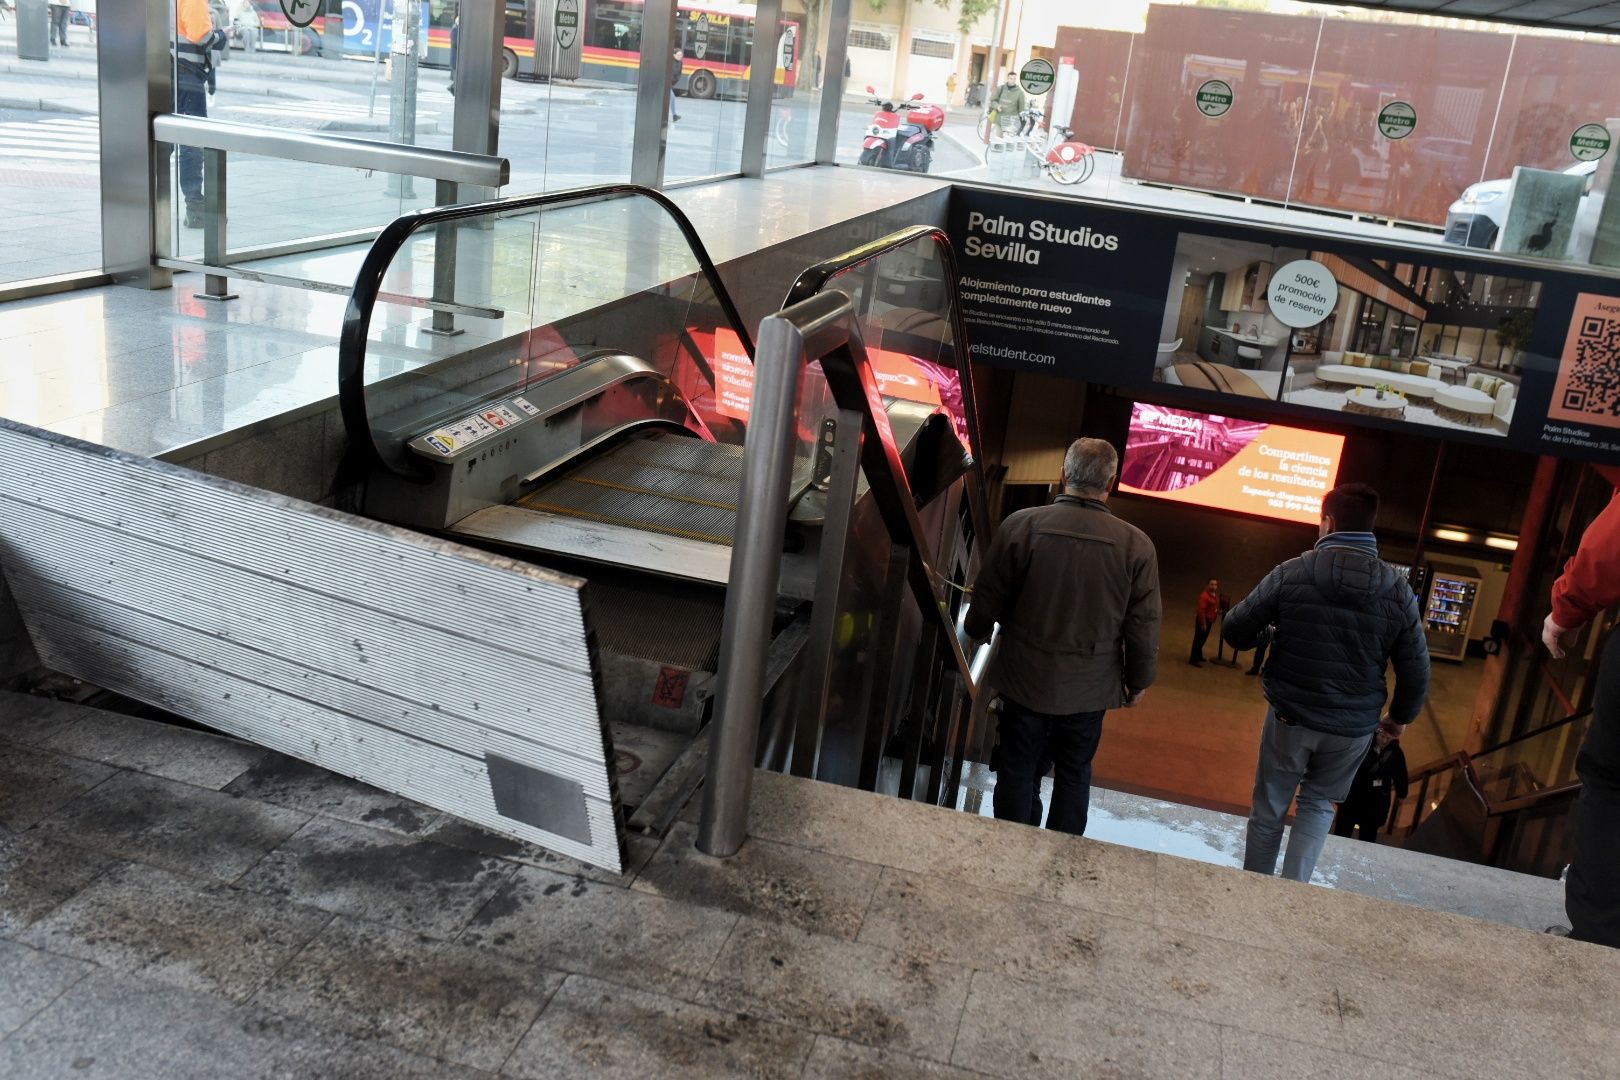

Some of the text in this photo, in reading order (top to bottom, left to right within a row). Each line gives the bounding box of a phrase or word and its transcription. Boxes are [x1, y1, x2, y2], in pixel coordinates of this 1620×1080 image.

[560, 13, 575, 24] Metro
[689, 11, 730, 25] SILLA
[1025, 72, 1050, 82] Metro
[1202, 93, 1227, 103] Metro
[1384, 115, 1410, 125] Metro
[1576, 138, 1604, 148] Metro
[968, 211, 1119, 251] Palm Studios
[965, 236, 1041, 265] Sevilla
[1295, 273, 1320, 288] 500€
[960, 276, 1111, 307] Alojamiento para estudiantes
[1277, 283, 1327, 304] promoción
[1040, 303, 1072, 315] nuevo
[1274, 294, 1324, 316] de reserva
[1543, 424, 1591, 438] Palm Studios
[1259, 445, 1331, 465] Compartimos
[1279, 460, 1328, 477] la ciencia
[1238, 465, 1327, 490] de los resultados
